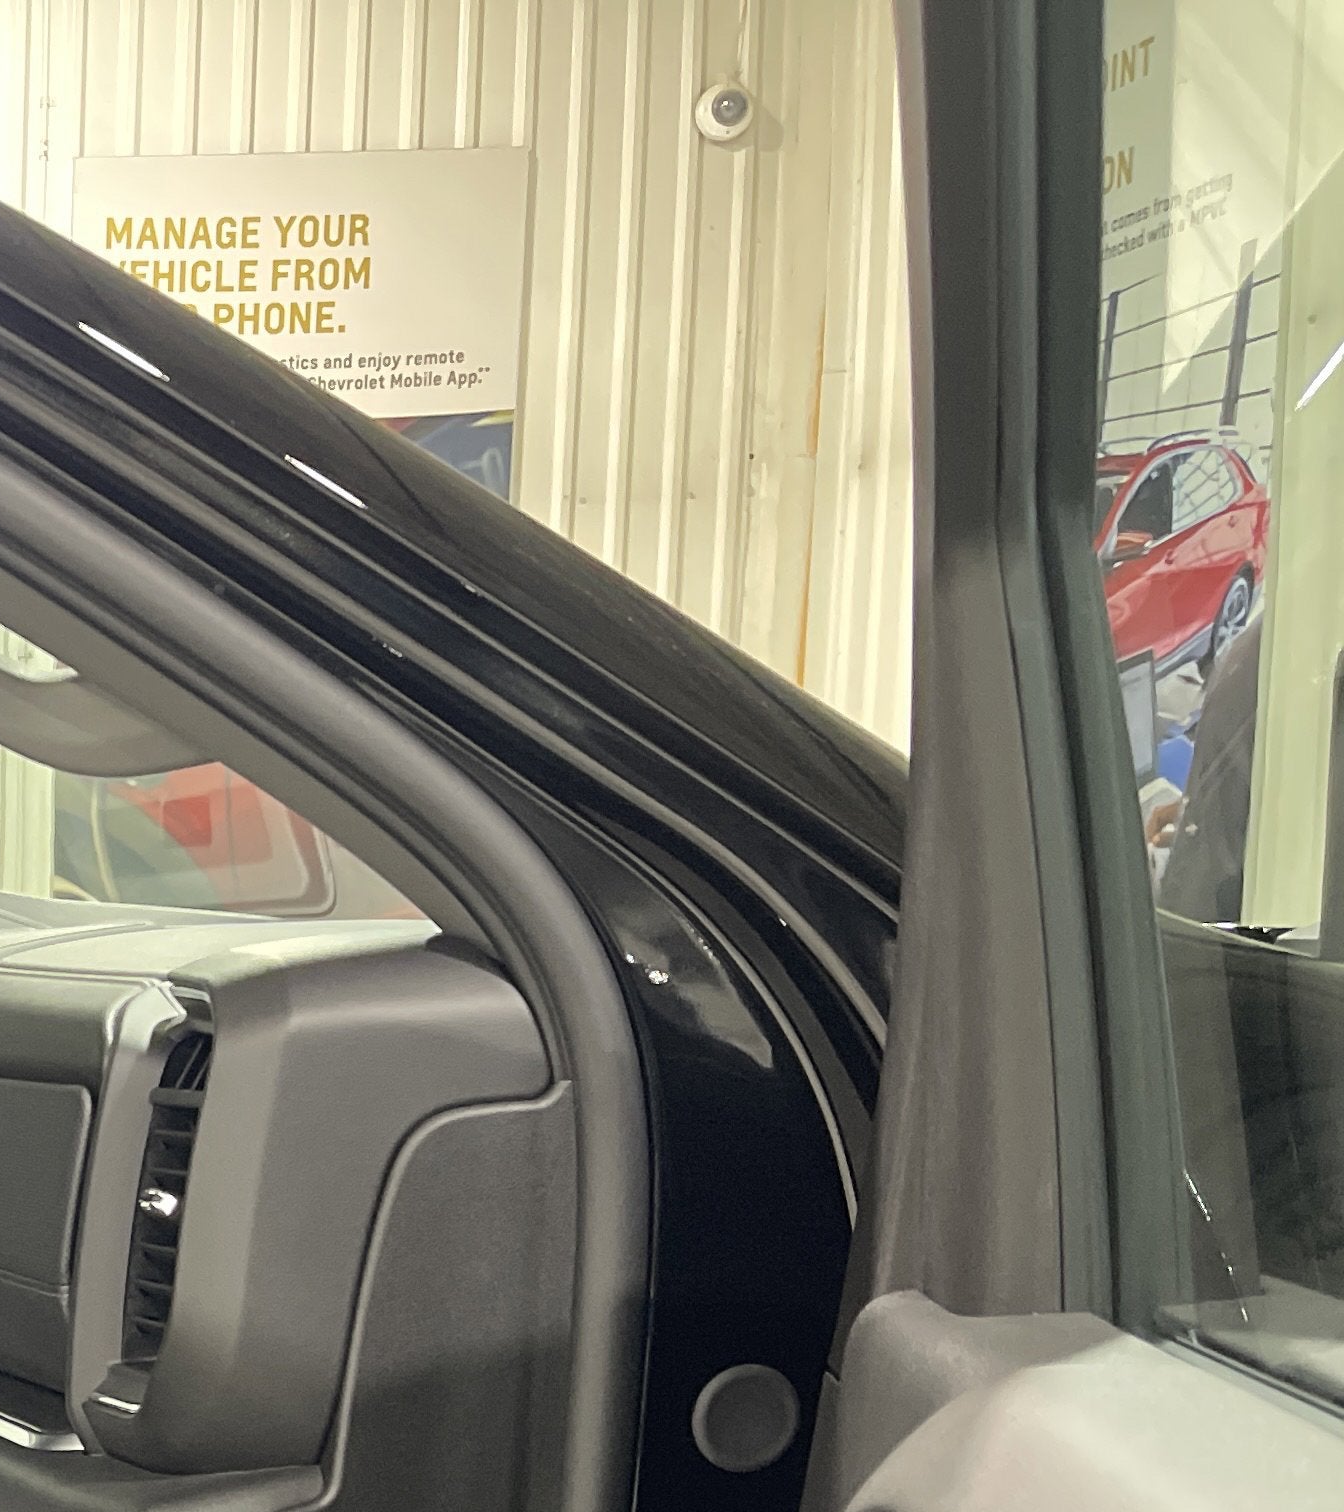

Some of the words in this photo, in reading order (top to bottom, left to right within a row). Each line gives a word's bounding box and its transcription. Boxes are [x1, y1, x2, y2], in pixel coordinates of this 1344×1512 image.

[105, 216, 261, 250] MANAGE
[273, 213, 370, 249] YOUR
[120, 259, 259, 293] EHICLE
[271, 256, 371, 292] FROM
[213, 300, 347, 335] PHONE.
[323, 352, 354, 370] and
[357, 351, 402, 373] enjoy
[405, 349, 465, 367] remote
[390, 371, 443, 389] Mobile
